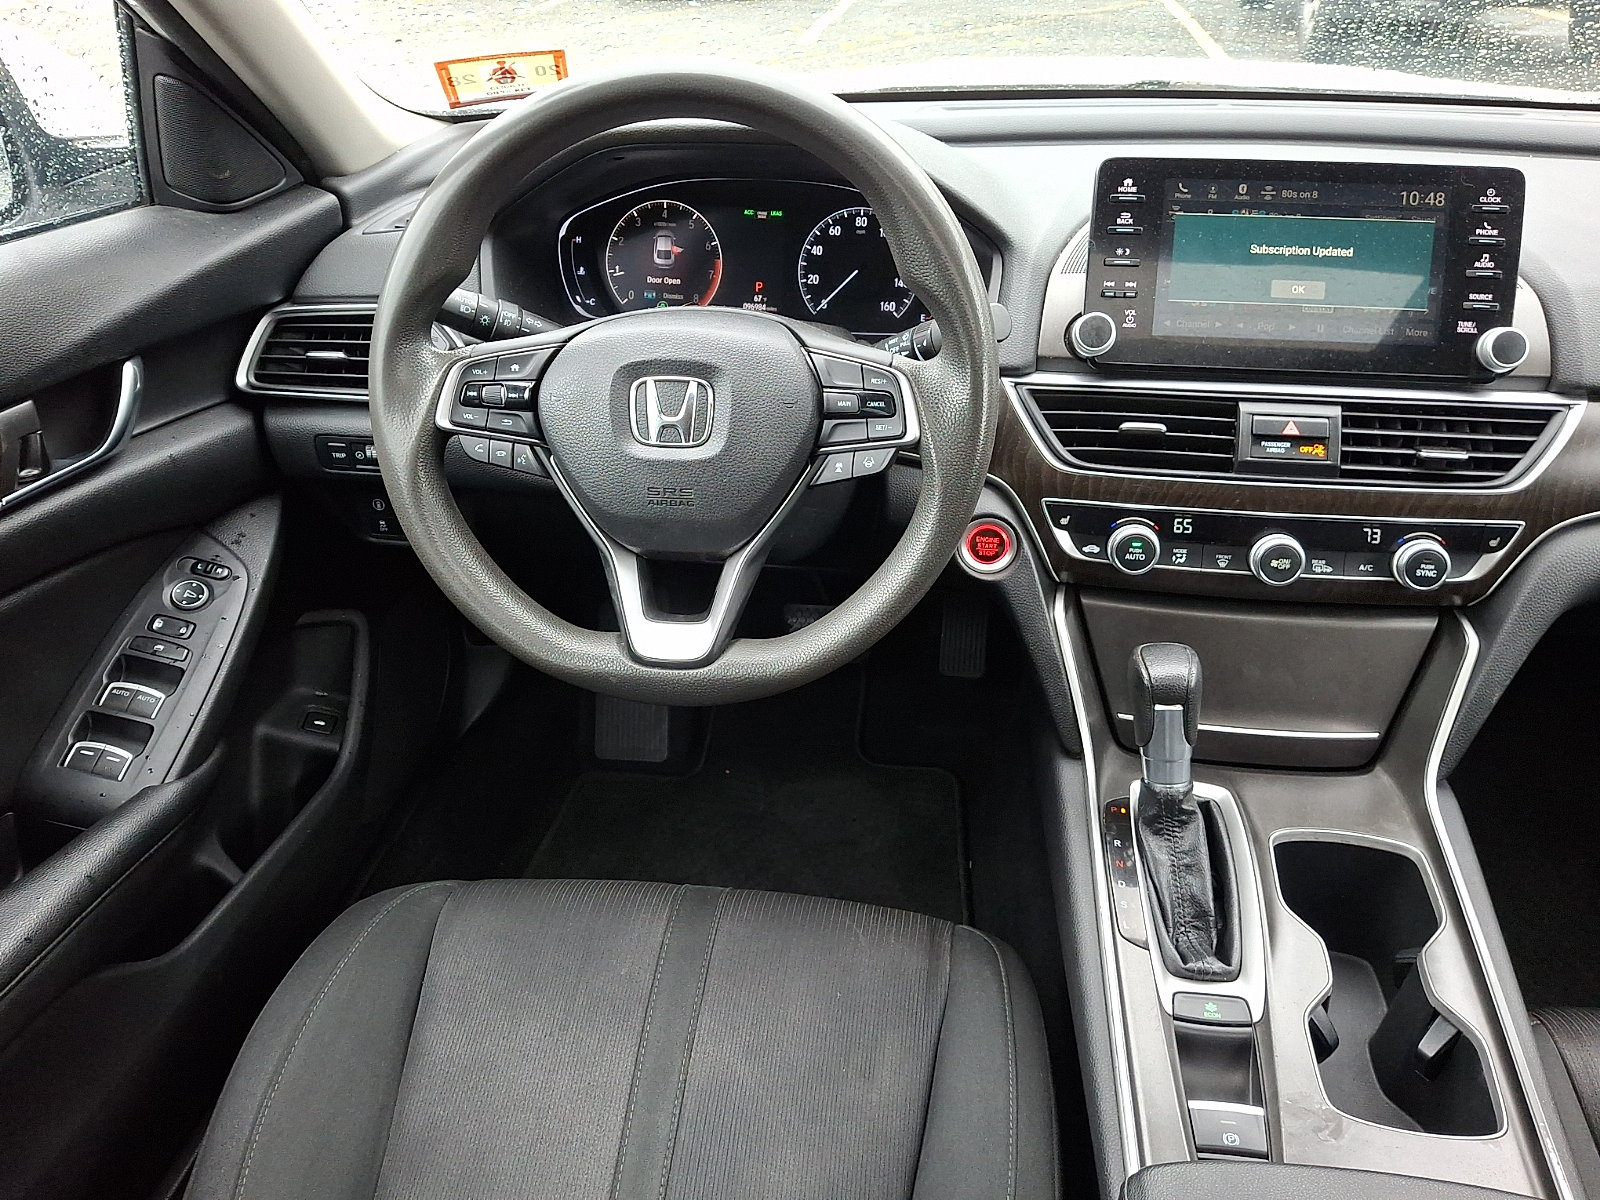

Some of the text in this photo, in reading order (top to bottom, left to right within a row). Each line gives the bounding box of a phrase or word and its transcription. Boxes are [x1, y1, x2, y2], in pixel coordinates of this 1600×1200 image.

[1300, 191, 1311, 199] on
[1400, 191, 1446, 207] 10:48
[661, 209, 668, 219] 4
[635, 217, 642, 227] 3
[688, 219, 695, 229] 5
[855, 217, 868, 228] 80
[829, 225, 841, 236] 60
[618, 236, 625, 246] 2
[705, 241, 712, 251] 6
[811, 245, 823, 256] 40
[1249, 244, 1354, 257] Subscription Updated
[708, 270, 714, 279] 7
[807, 274, 820, 285] 20
[646, 276, 681, 286] Door Open
[894, 277, 907, 289] 14
[755, 281, 763, 292] P
[1291, 285, 1306, 294] OK
[628, 290, 635, 300] 0
[663, 292, 684, 300] Dismiss
[693, 293, 699, 303] 8
[880, 301, 896, 312] 160
[920, 313, 926, 322] E
[1176, 319, 1210, 329] Channel
[1405, 328, 1429, 337] More
[647, 487, 694, 497] SRS
[647, 499, 695, 507] AIRBAG
[1173, 518, 1193, 534] 65
[975, 535, 1000, 543] ENGINE
[1362, 528, 1382, 544] 73
[1358, 563, 1374, 572] A/C
[1415, 569, 1437, 577] SYNC
[111, 688, 130, 697] AUTO
[137, 694, 156, 703] AUTO
[1113, 839, 1122, 847] R
[1116, 860, 1124, 868] N
[1117, 880, 1126, 888] D
[1123, 920, 1130, 929] L
[1203, 1011, 1222, 1019] ECON
